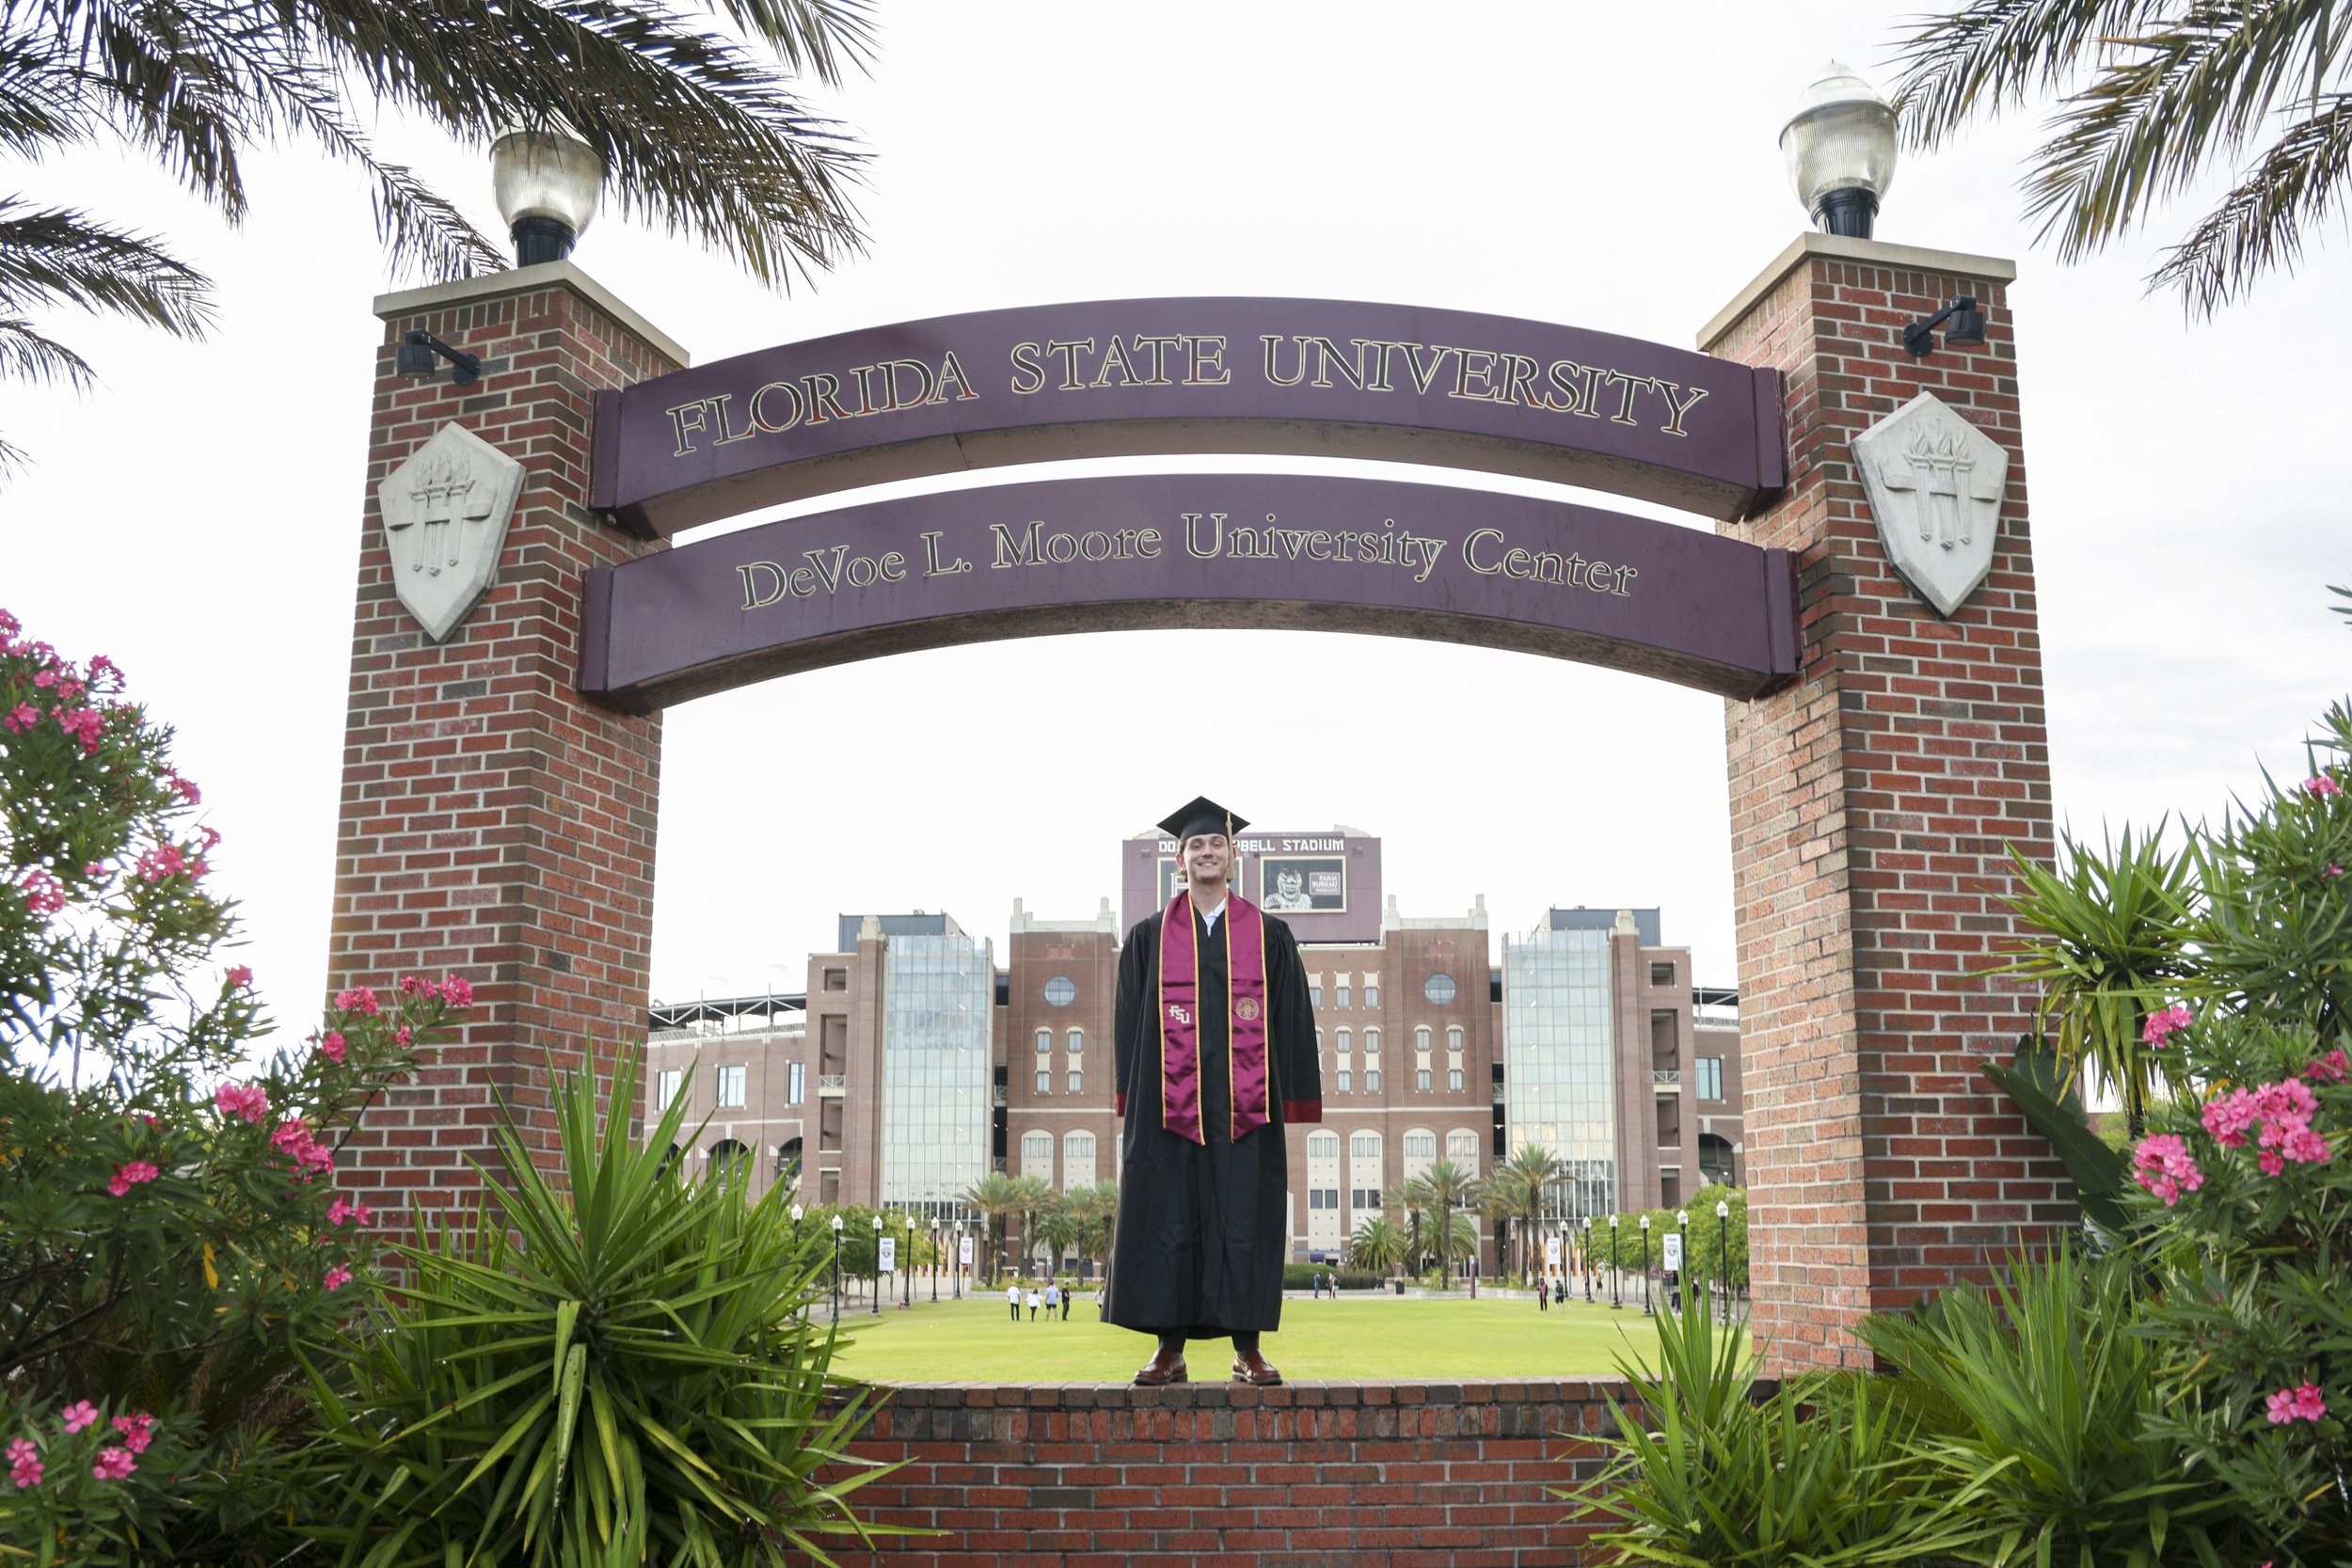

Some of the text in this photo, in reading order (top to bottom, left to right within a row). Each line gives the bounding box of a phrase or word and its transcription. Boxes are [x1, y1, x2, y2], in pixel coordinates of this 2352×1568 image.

[666, 333, 1709, 457] FLORIDA STATE UNIVERSITY
[735, 512, 1639, 612] DeVoe L. Moore University Center
[1282, 839, 1344, 851] STADIUM
[1168, 1005, 1190, 1024] FSU
